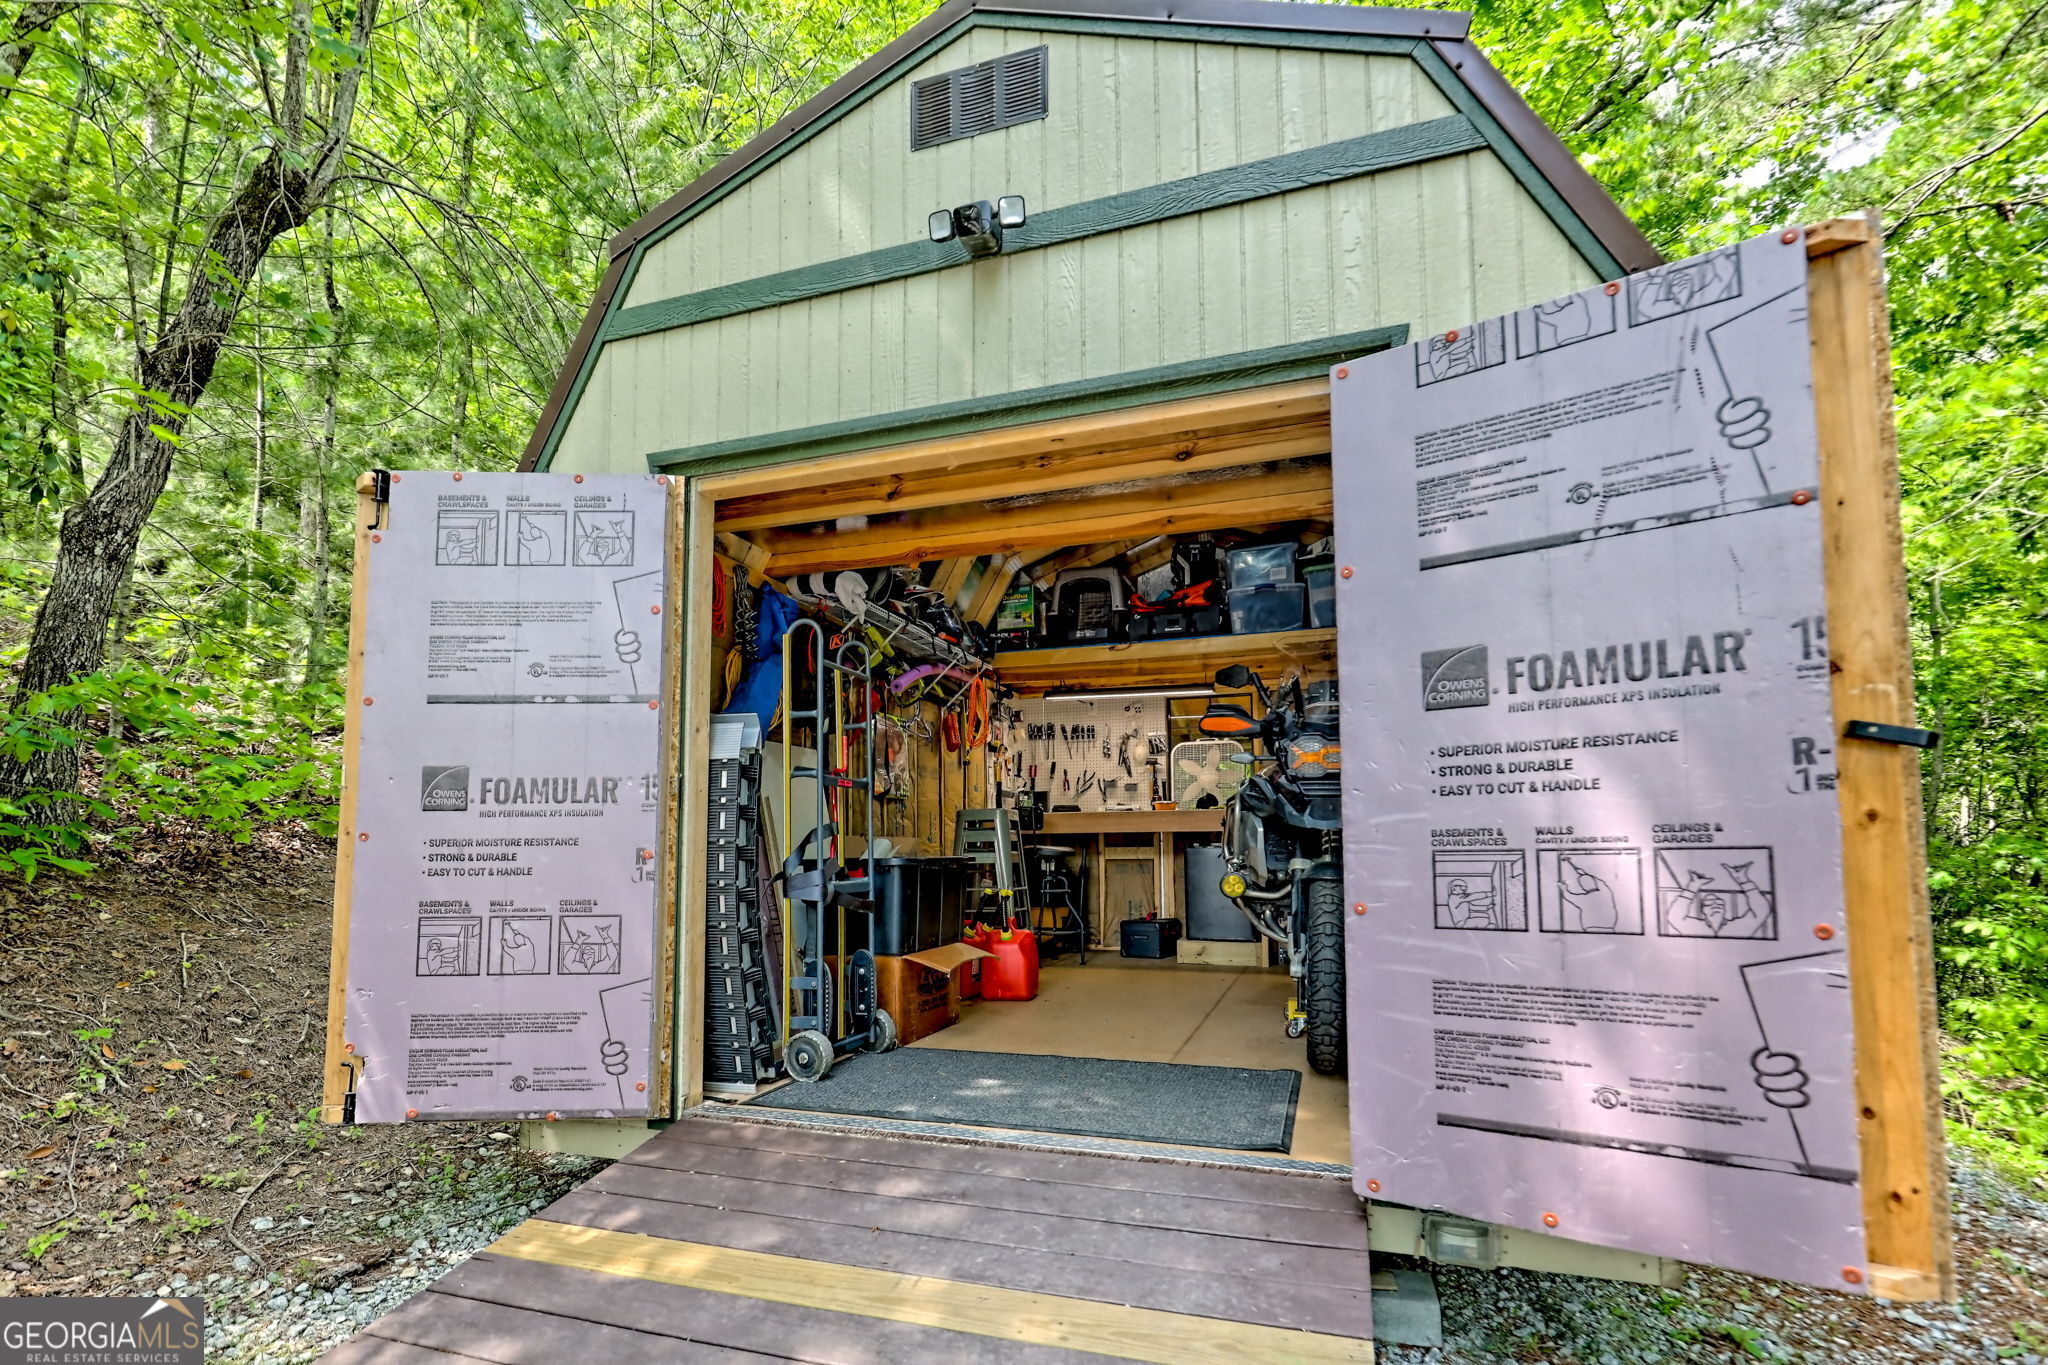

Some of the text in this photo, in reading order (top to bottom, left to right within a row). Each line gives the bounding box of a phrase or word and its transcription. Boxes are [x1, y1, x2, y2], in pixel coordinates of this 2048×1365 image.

[1507, 631, 1746, 694] FOAMULAR
[1438, 678, 1486, 692] OWENS
[1428, 688, 1486, 703] CORNING
[1508, 684, 1721, 713] HIGH PERFORMANCE XPS INSULATION
[1438, 730, 1679, 758] SUPERIOR MOISTURE RESISTANCE
[1438, 758, 1573, 777] STRONG & DURABLE
[480, 777, 618, 805] FOAMULAR
[1440, 778, 1601, 796] EASY TO CUT & HANDLE
[432, 790, 466, 798] OWENS
[424, 797, 466, 806] CORNING
[480, 810, 496, 818] HIGH
[498, 810, 548, 818] PERFORMANCE
[564, 809, 604, 817] INSULATION
[1431, 828, 1504, 838] BASEMENTS &
[1535, 826, 1574, 836] WALLS
[1652, 823, 1724, 833] CEILINGS &
[428, 838, 580, 848] SUPERIOR MOISTURE RESISTANCE
[1431, 838, 1508, 847] CRAWLSPACES
[1652, 834, 1714, 844] GARAGES
[428, 852, 518, 862] STRONG & DURABLE
[428, 867, 533, 876] EASY TO CUT & HANDLE
[418, 900, 462, 908] BASEMENTS
